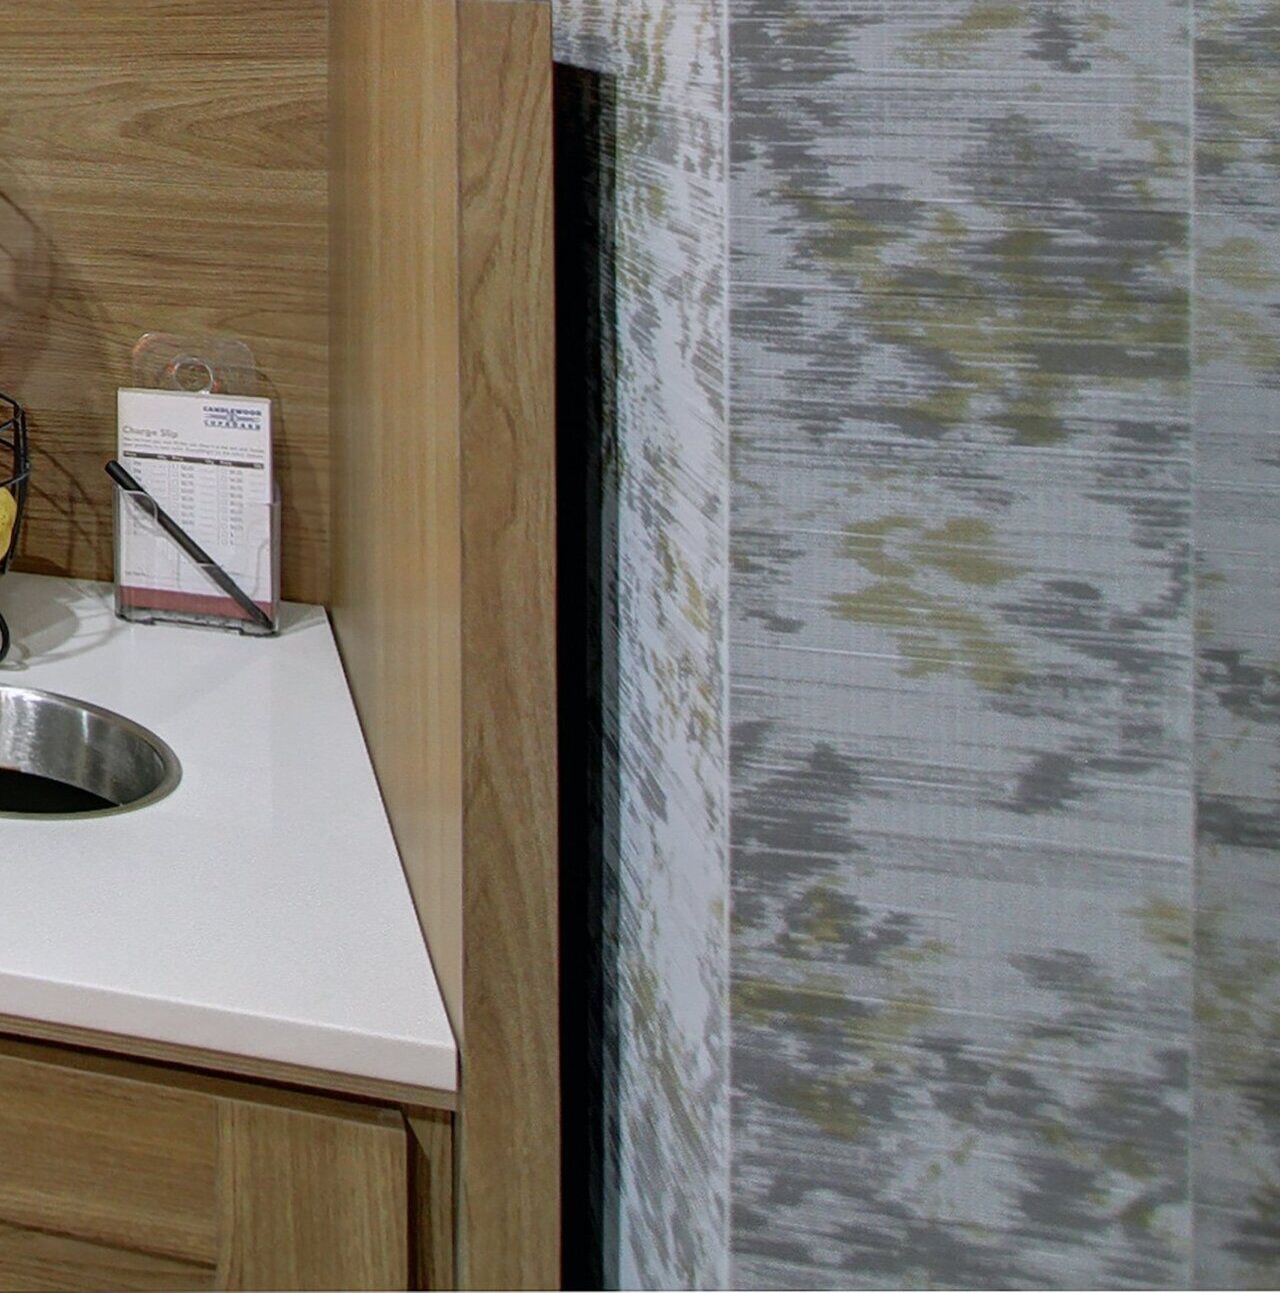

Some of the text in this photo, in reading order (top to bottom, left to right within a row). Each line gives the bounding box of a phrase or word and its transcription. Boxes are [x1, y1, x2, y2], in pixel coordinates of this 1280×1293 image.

[203, 406, 262, 417] CANDLEWOOD
[204, 418, 261, 431] CUPBOARD
[122, 425, 178, 439] Charge Slip
